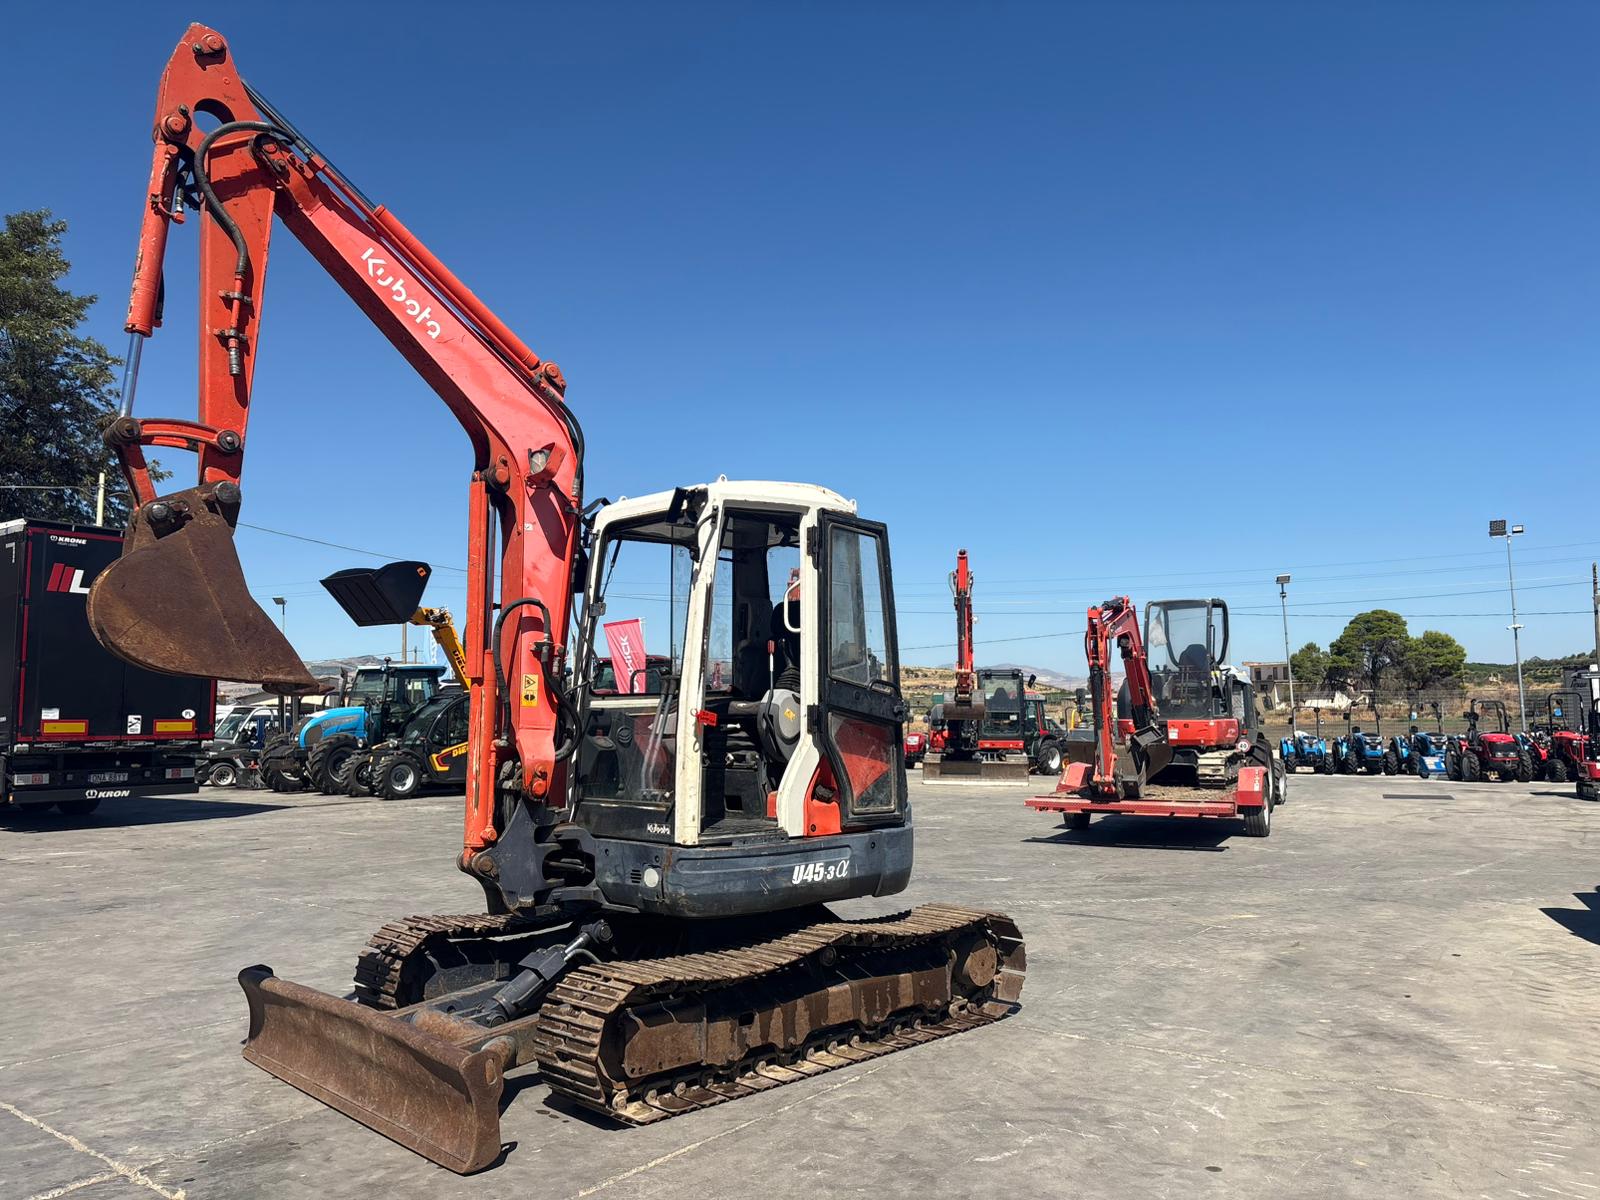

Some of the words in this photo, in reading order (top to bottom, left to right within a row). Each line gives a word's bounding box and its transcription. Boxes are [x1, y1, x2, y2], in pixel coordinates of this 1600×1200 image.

[361, 247, 441, 340] Kubota
[58, 536, 88, 545] KRONE
[98, 790, 130, 798] KRON
[647, 823, 670, 835] Kubota
